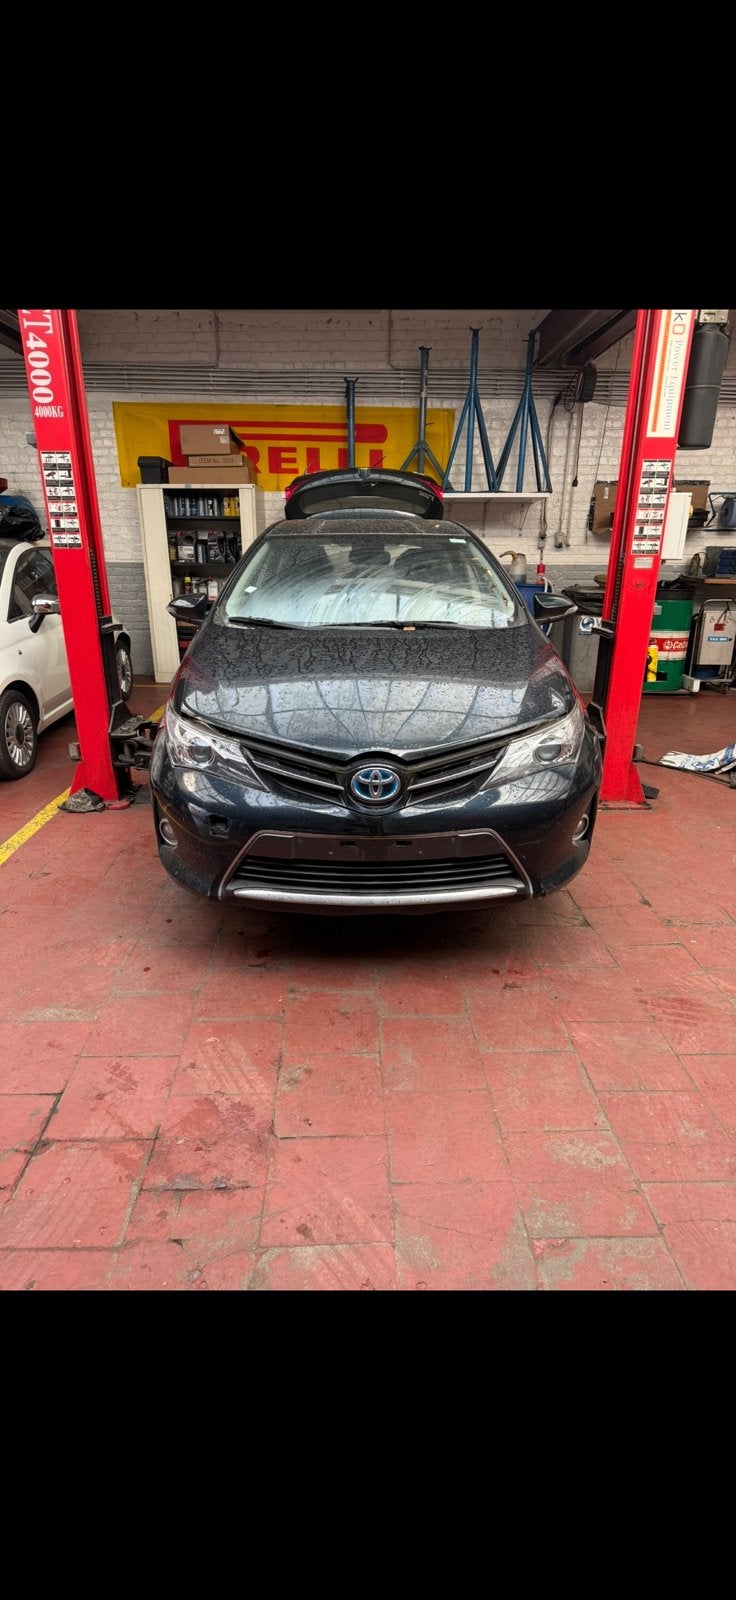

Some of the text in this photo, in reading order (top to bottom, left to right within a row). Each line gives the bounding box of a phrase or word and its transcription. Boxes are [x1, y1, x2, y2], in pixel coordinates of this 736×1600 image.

[22, 309, 54, 404] T4000
[671, 340, 683, 374] Power
[34, 406, 64, 418] 4000KG
[663, 375, 679, 431] Equipment
